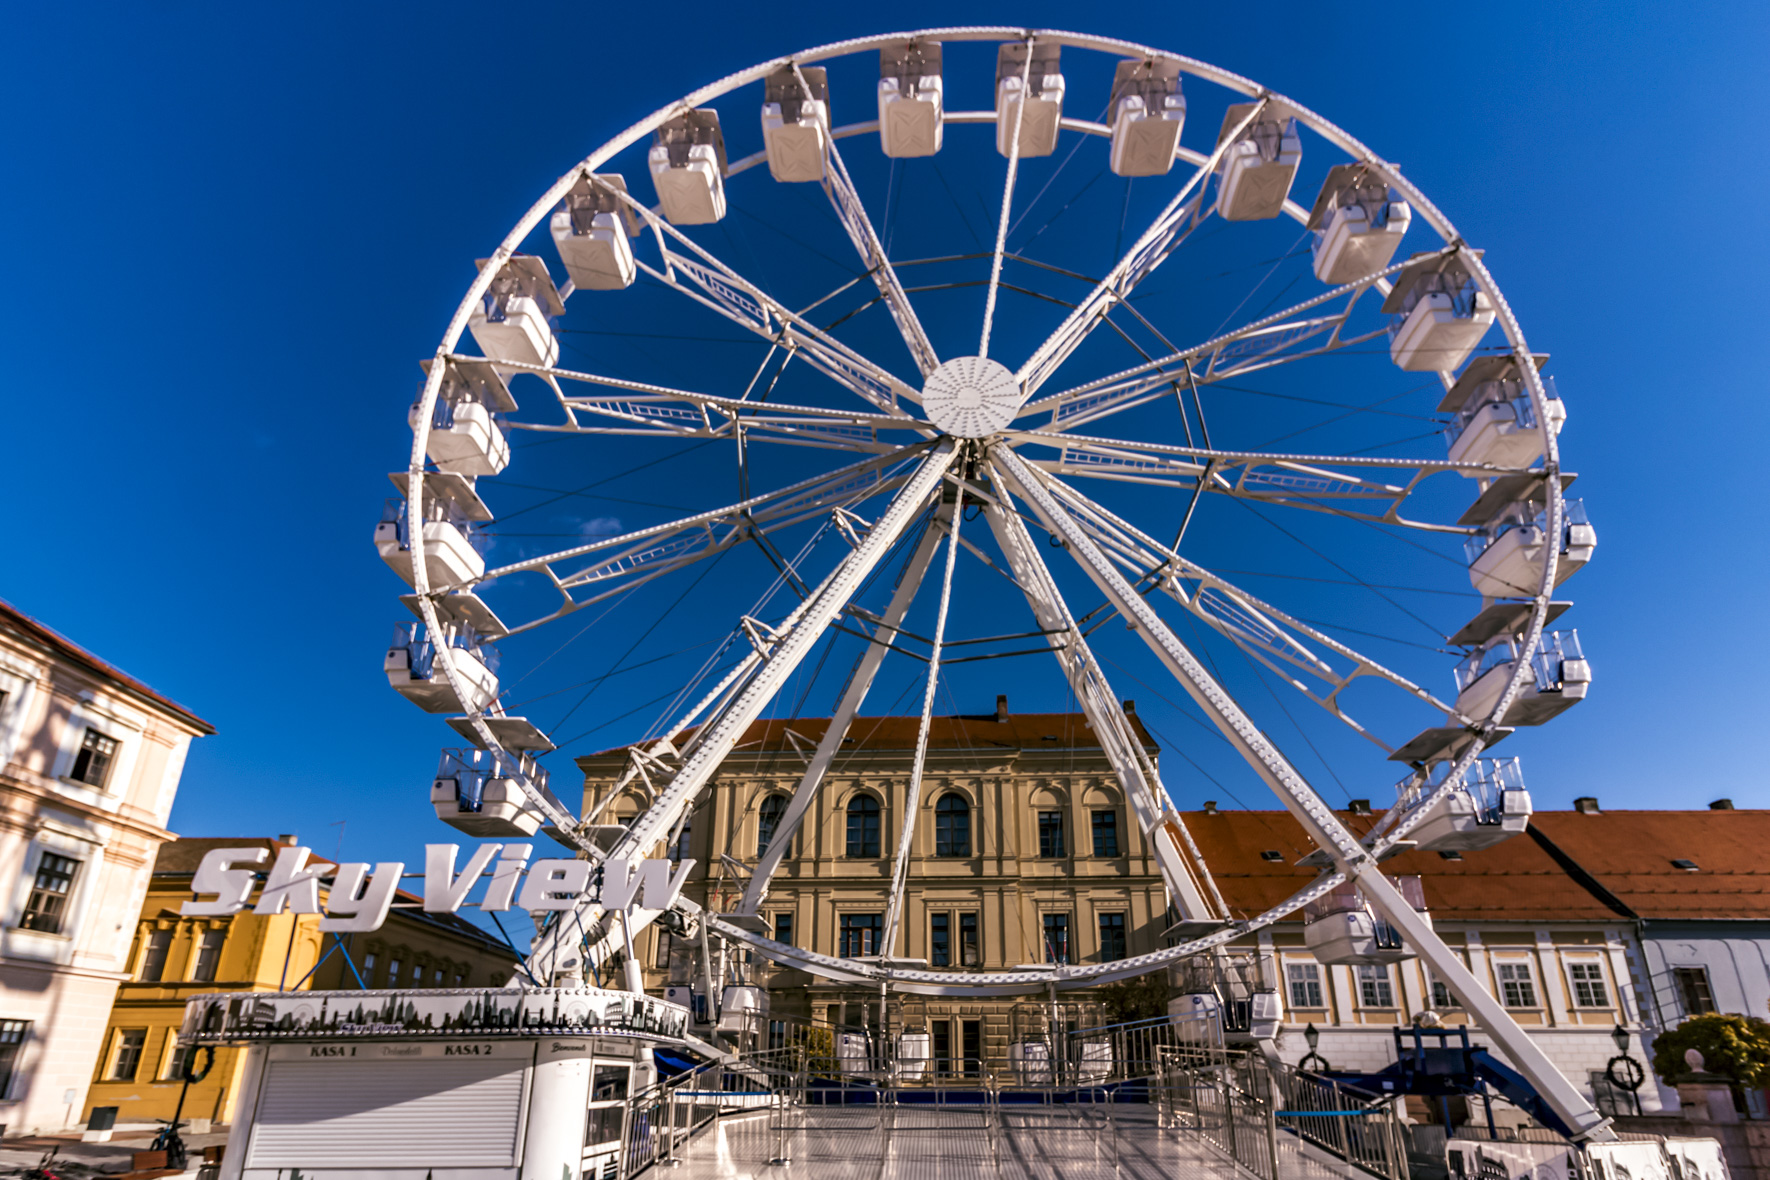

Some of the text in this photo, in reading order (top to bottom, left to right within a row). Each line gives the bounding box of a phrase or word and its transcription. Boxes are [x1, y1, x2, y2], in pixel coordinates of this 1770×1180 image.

[179, 846, 405, 933] Sky
[310, 1046, 357, 1057] KASA 1
[444, 1044, 493, 1056] KASA 2
